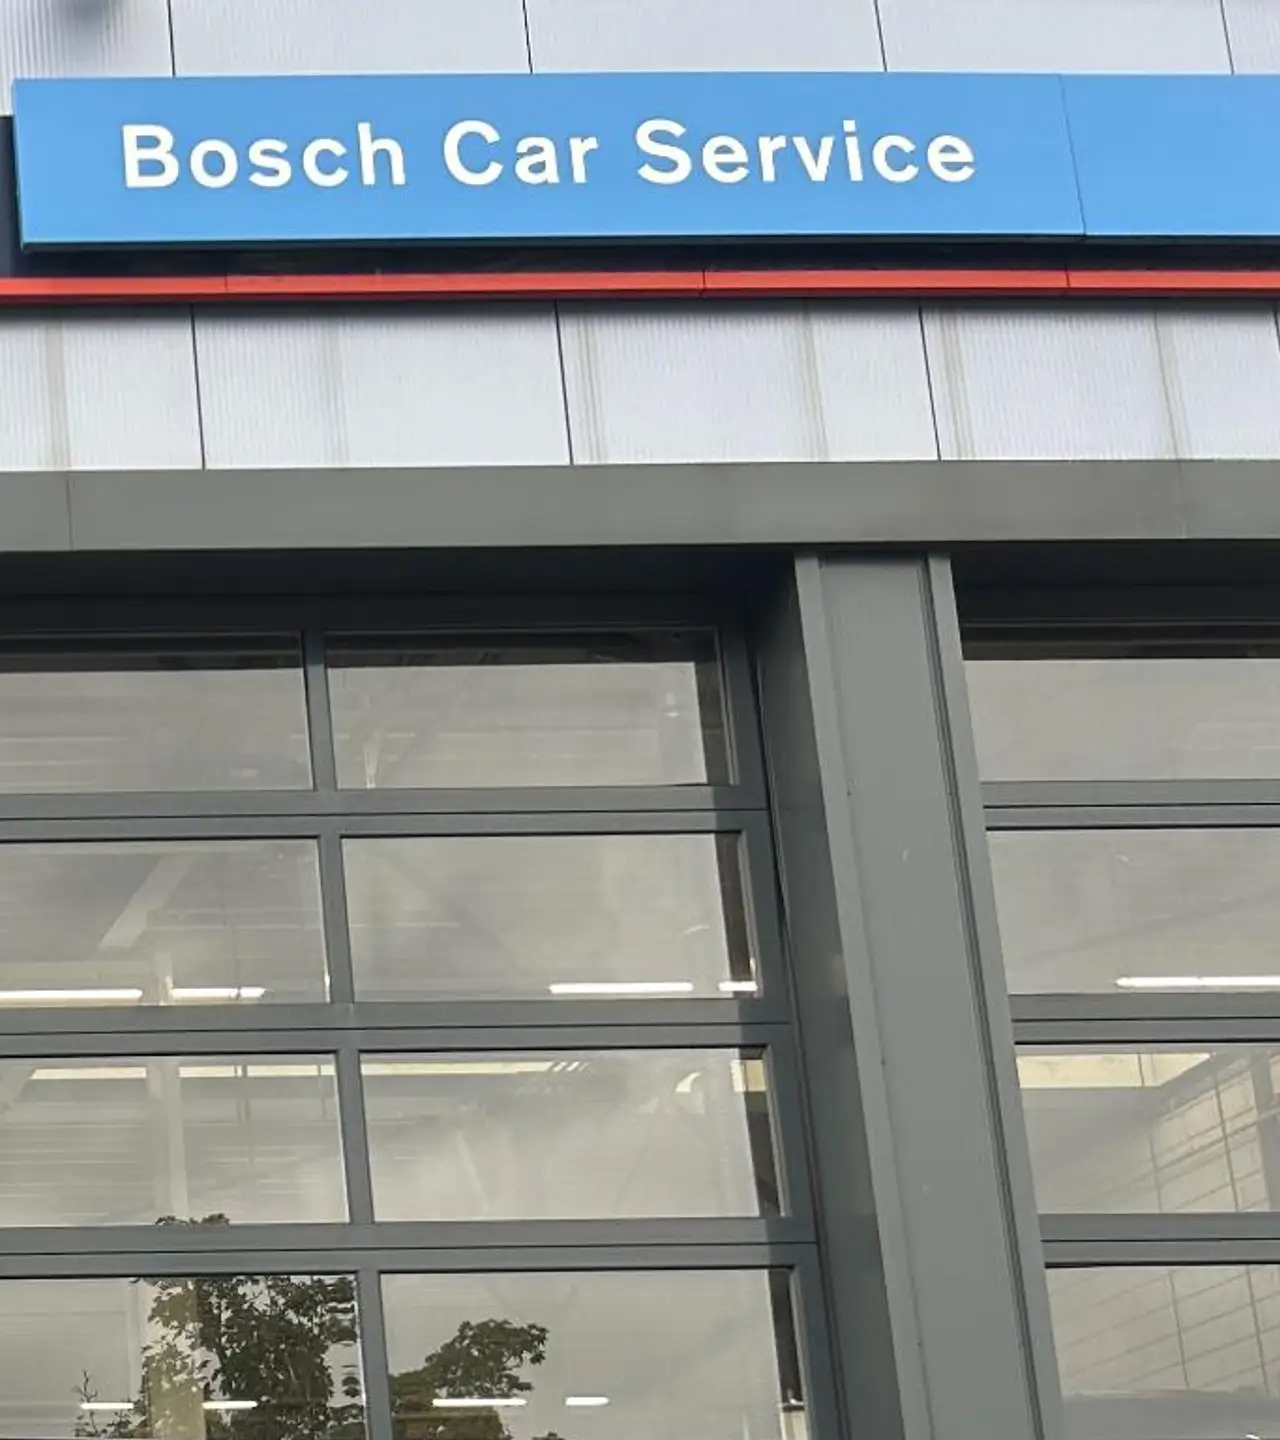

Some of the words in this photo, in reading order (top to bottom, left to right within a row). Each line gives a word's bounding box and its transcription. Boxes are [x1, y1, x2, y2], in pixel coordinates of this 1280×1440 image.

[121, 120, 406, 188] Bosch
[443, 119, 599, 186] Car
[635, 118, 976, 185] Service
